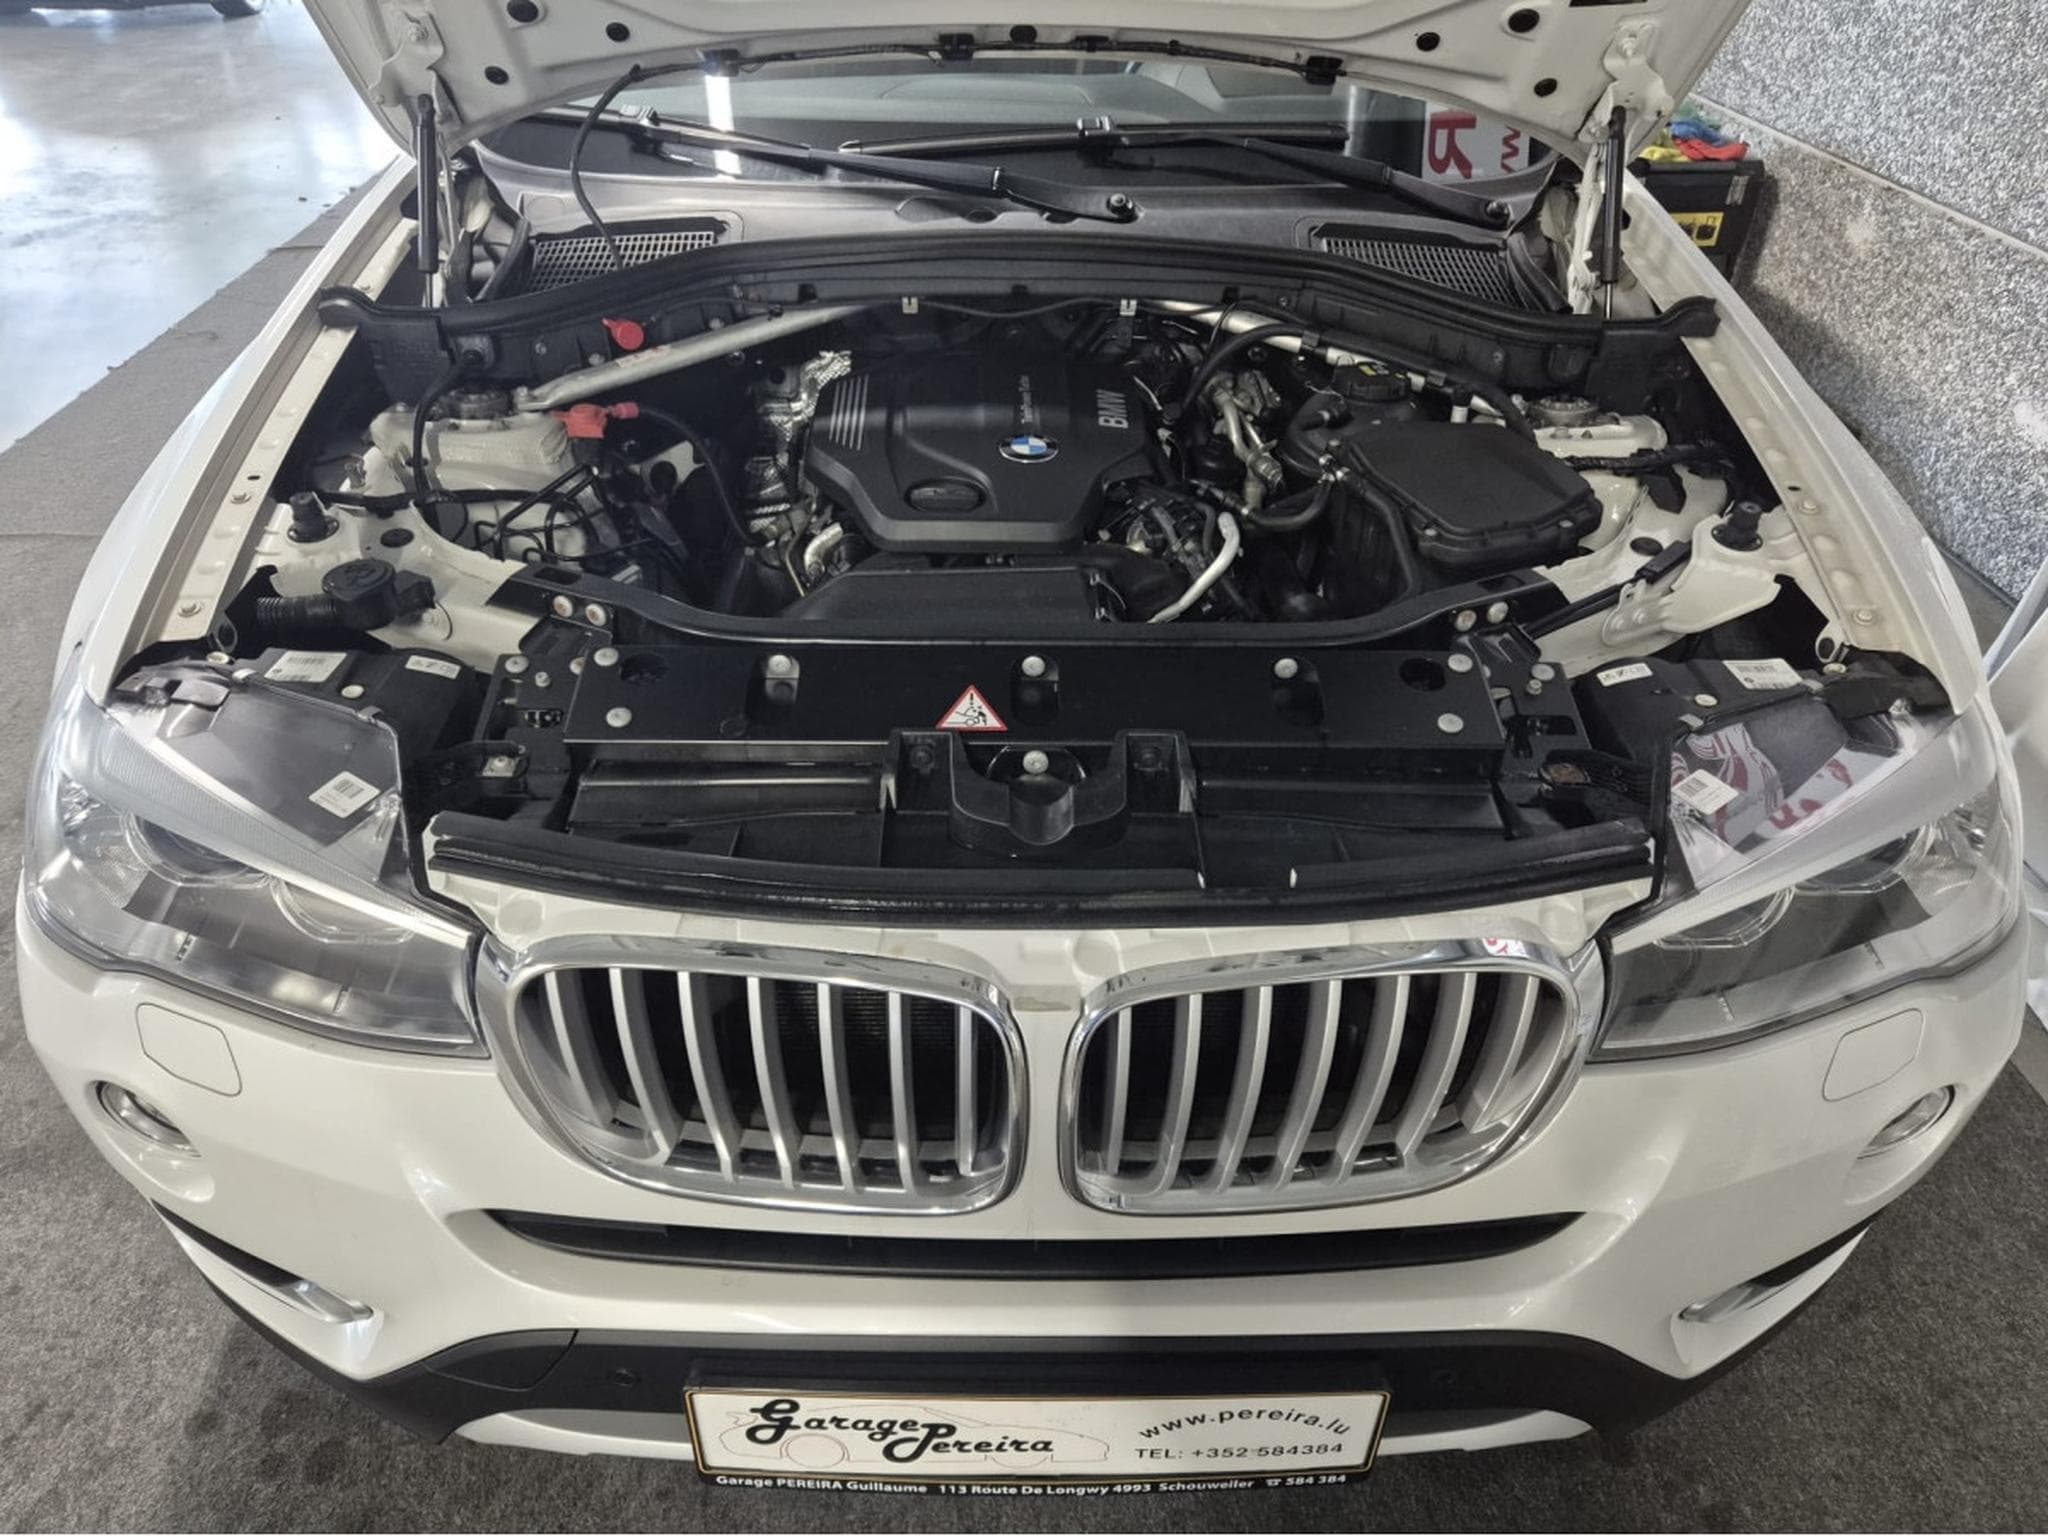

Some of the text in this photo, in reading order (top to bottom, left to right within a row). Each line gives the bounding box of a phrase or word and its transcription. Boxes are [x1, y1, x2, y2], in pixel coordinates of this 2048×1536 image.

[1096, 388, 1129, 429] BMW
[745, 1399, 922, 1445] Garage
[1138, 1407, 1352, 1440] www.pereira.lu
[881, 1422, 1054, 1464] Pereira
[1134, 1442, 1345, 1460] TEL: +352 584384
[715, 1474, 1347, 1497] Garage PEREIRA Guillaume 113 Route De Longwy 4993 Schouweiler 584 384
